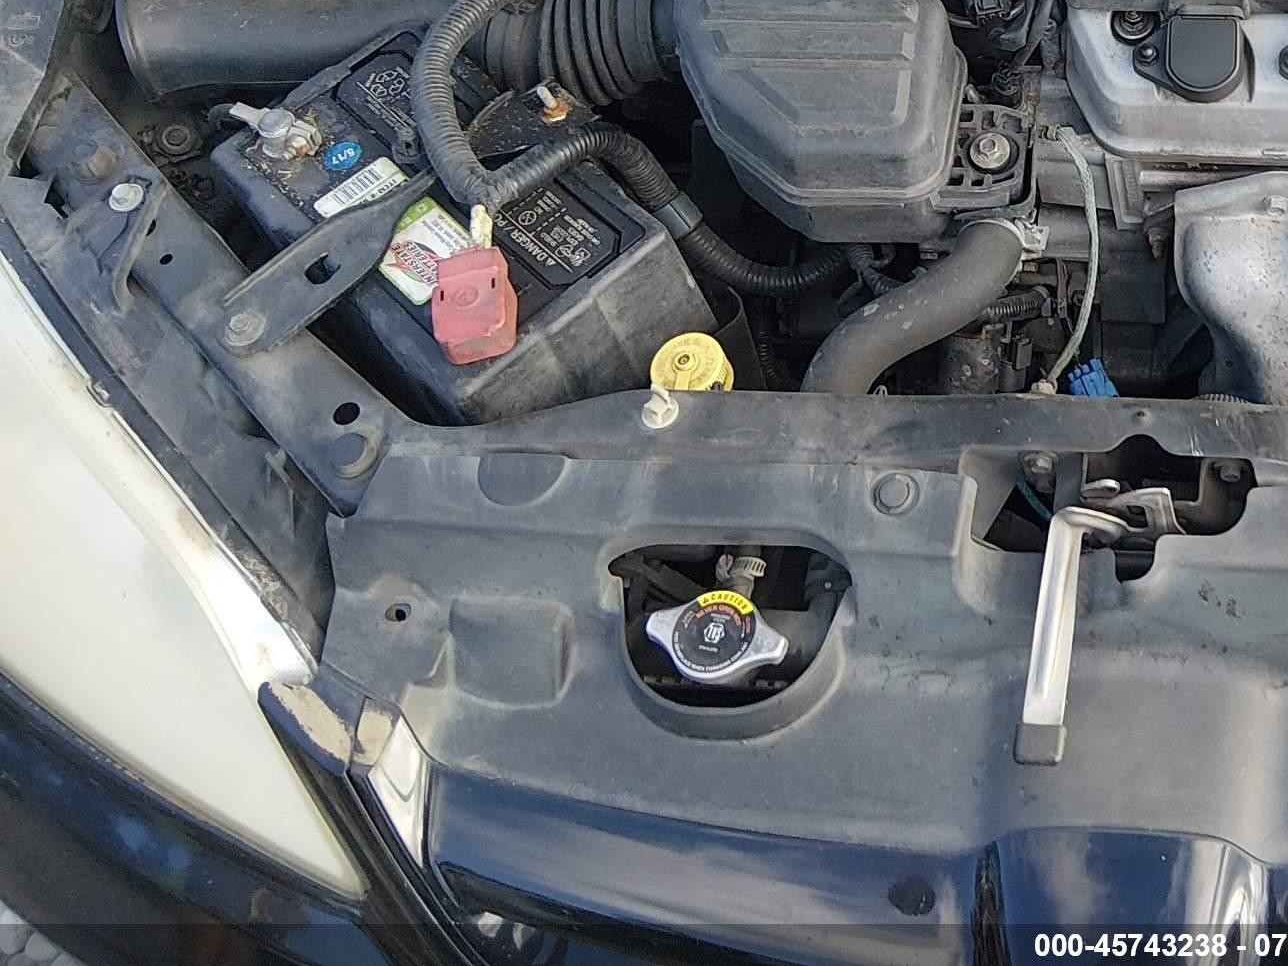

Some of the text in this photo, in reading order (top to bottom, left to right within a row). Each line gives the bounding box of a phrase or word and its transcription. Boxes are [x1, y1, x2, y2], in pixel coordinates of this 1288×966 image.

[332, 148, 356, 164] 5/17
[510, 230, 546, 261] DANGER
[391, 242, 437, 287] INTERSTATE
[711, 593, 748, 609] CAUTION
